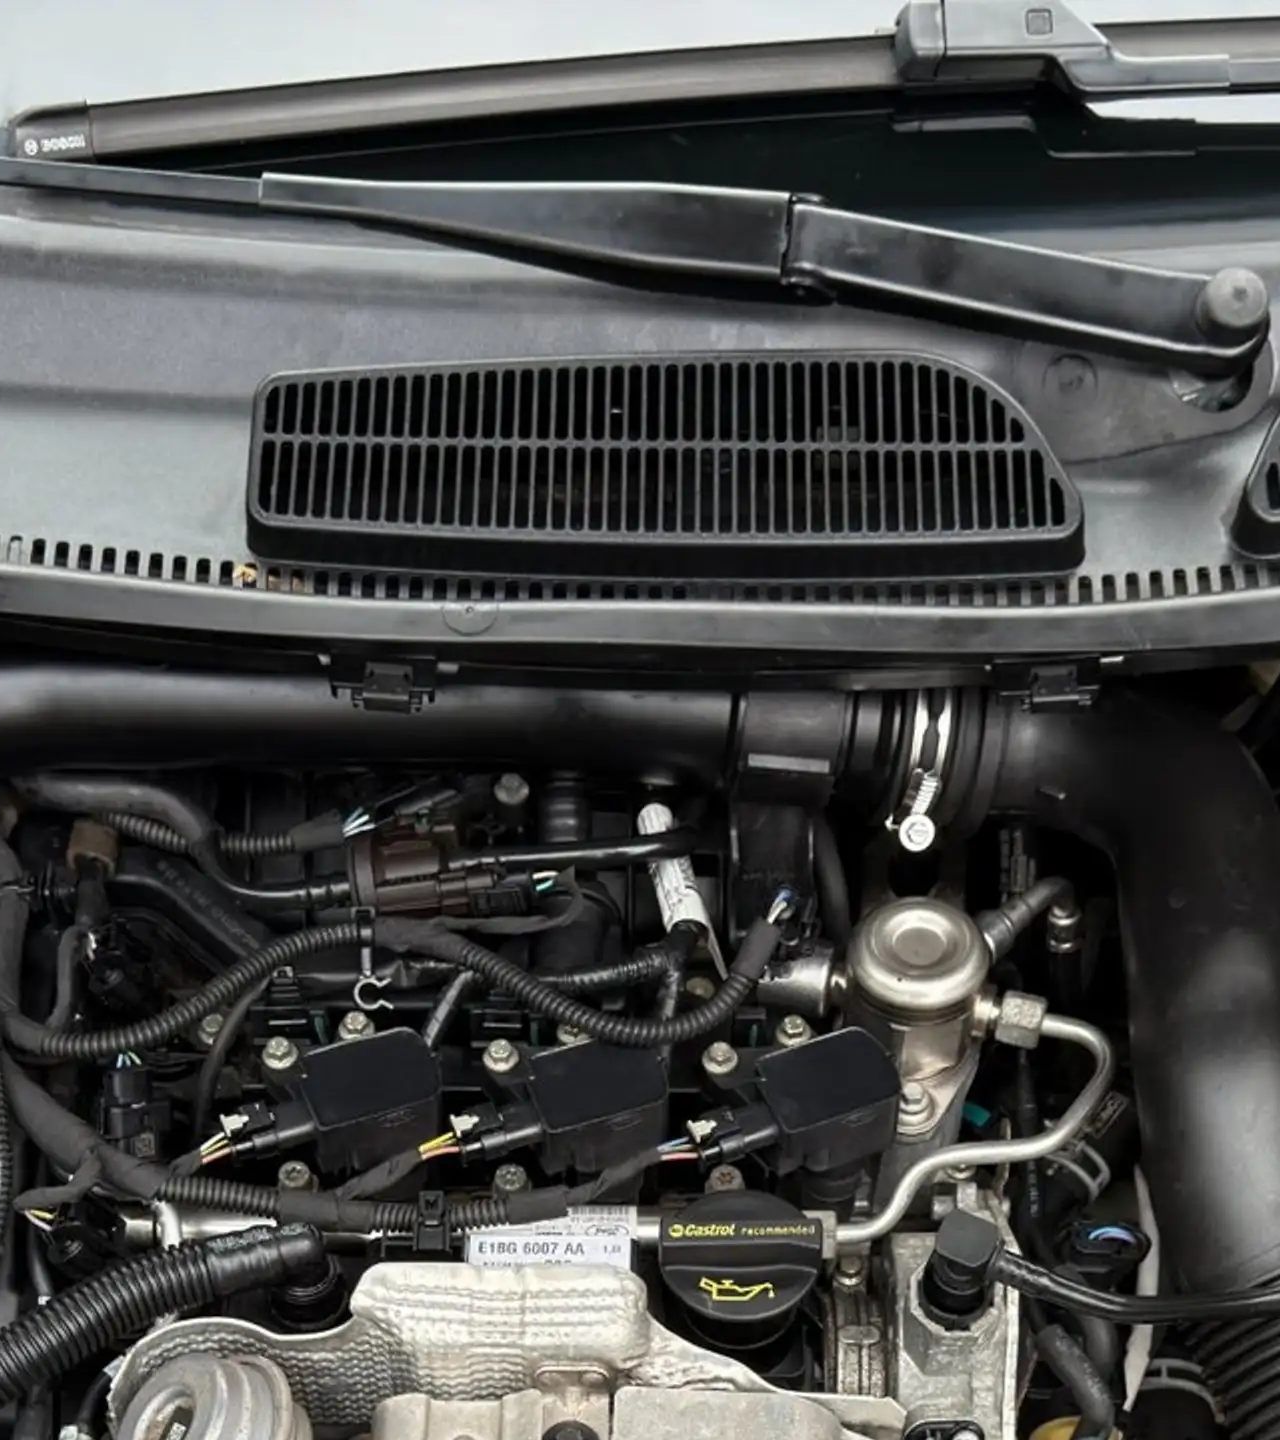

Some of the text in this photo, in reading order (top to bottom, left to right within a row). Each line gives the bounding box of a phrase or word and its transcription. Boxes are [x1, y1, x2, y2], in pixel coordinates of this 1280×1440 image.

[685, 1224, 816, 1236] Castrol recommended
[563, 1243, 585, 1255] AA
